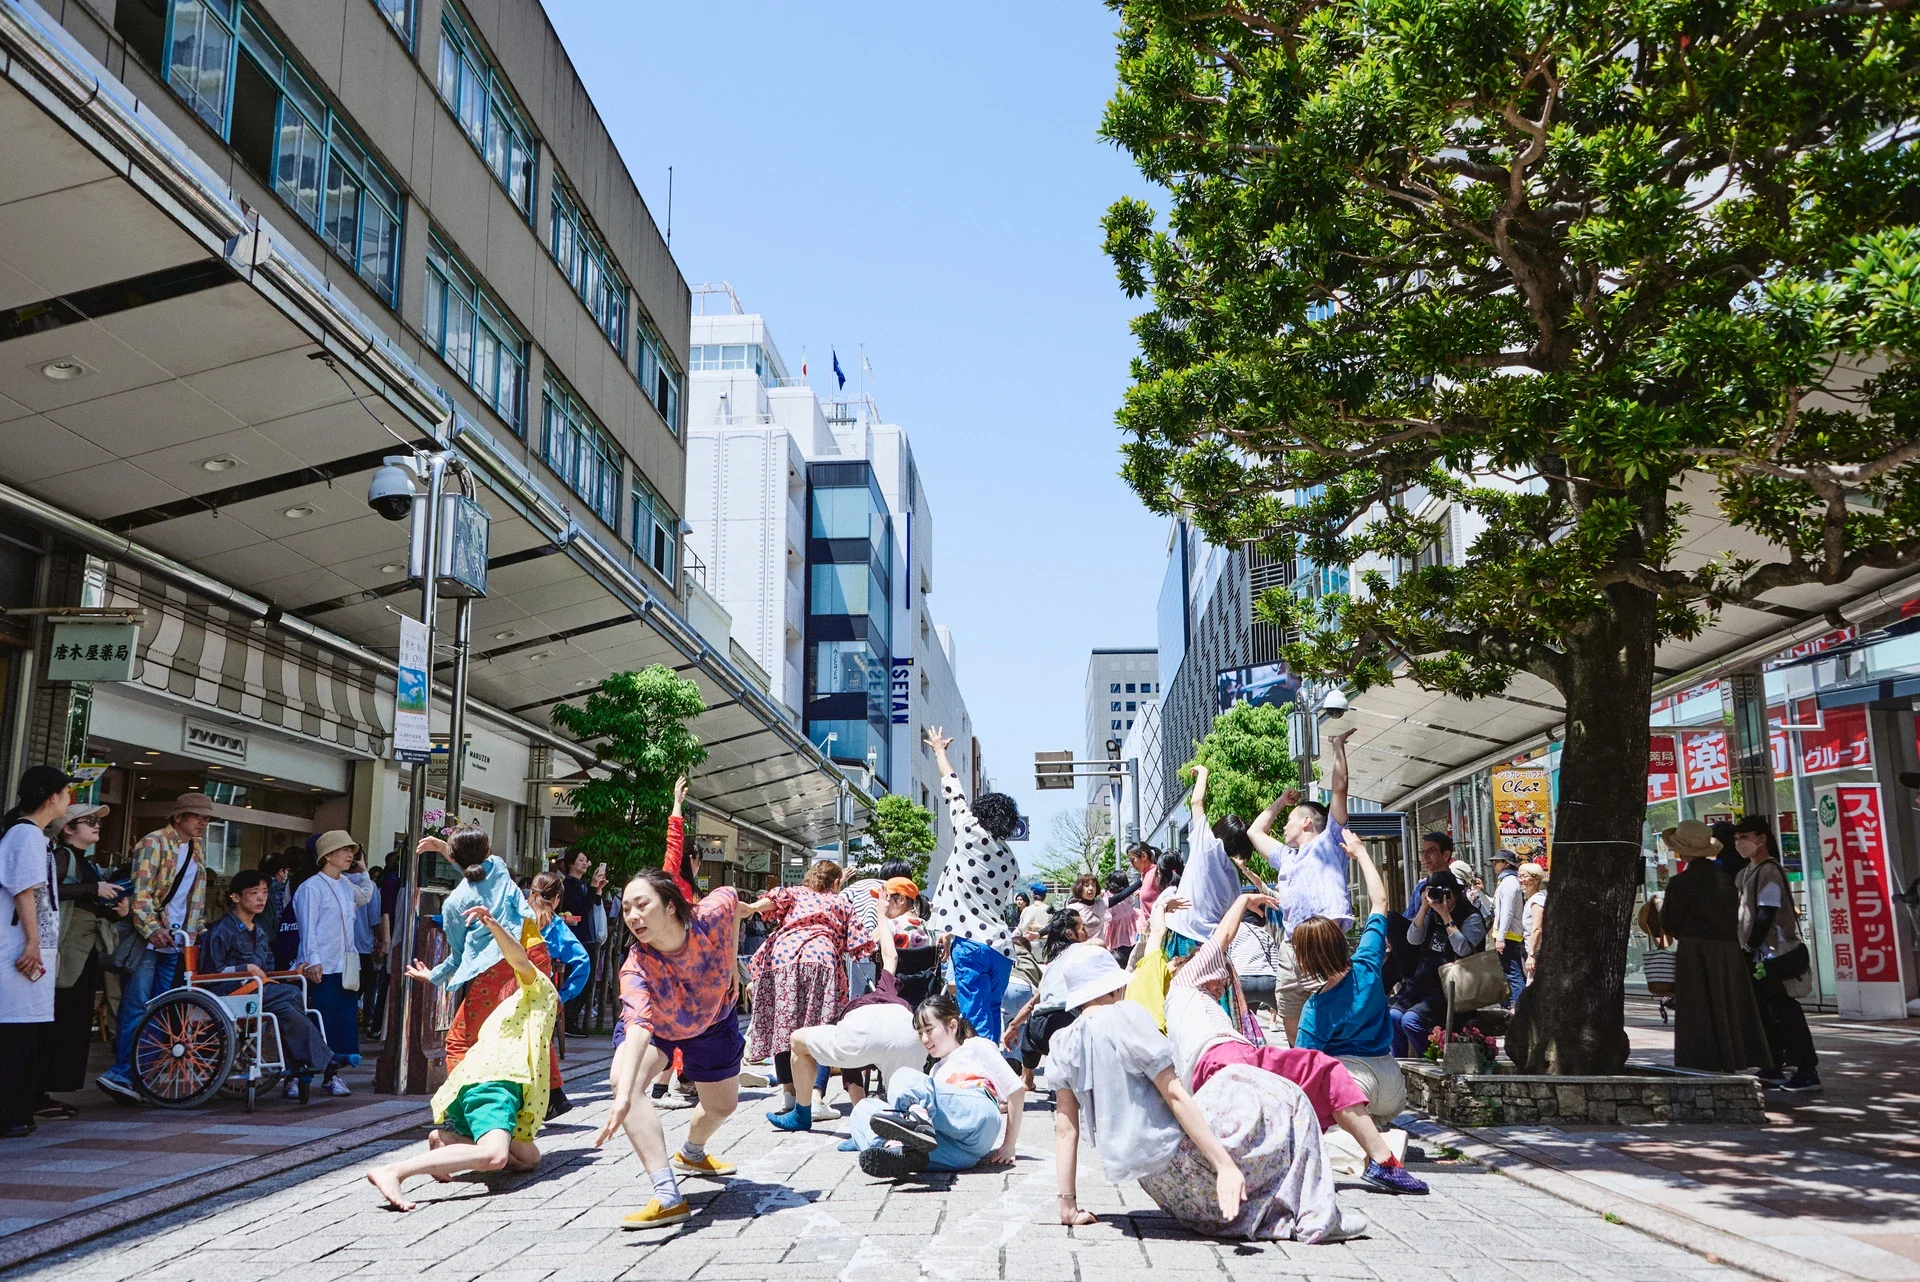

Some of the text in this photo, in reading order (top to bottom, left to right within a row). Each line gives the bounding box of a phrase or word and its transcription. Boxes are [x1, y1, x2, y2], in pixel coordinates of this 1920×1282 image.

[54, 643, 129, 661] 唐木屋薬局
[892, 657, 914, 724] ISETAN
[469, 750, 490, 763] MARUZEN
[1501, 780, 1540, 793] Chai
[1823, 838, 1854, 969] スギ薬局
[1843, 794, 1893, 975] スギドラッグ
